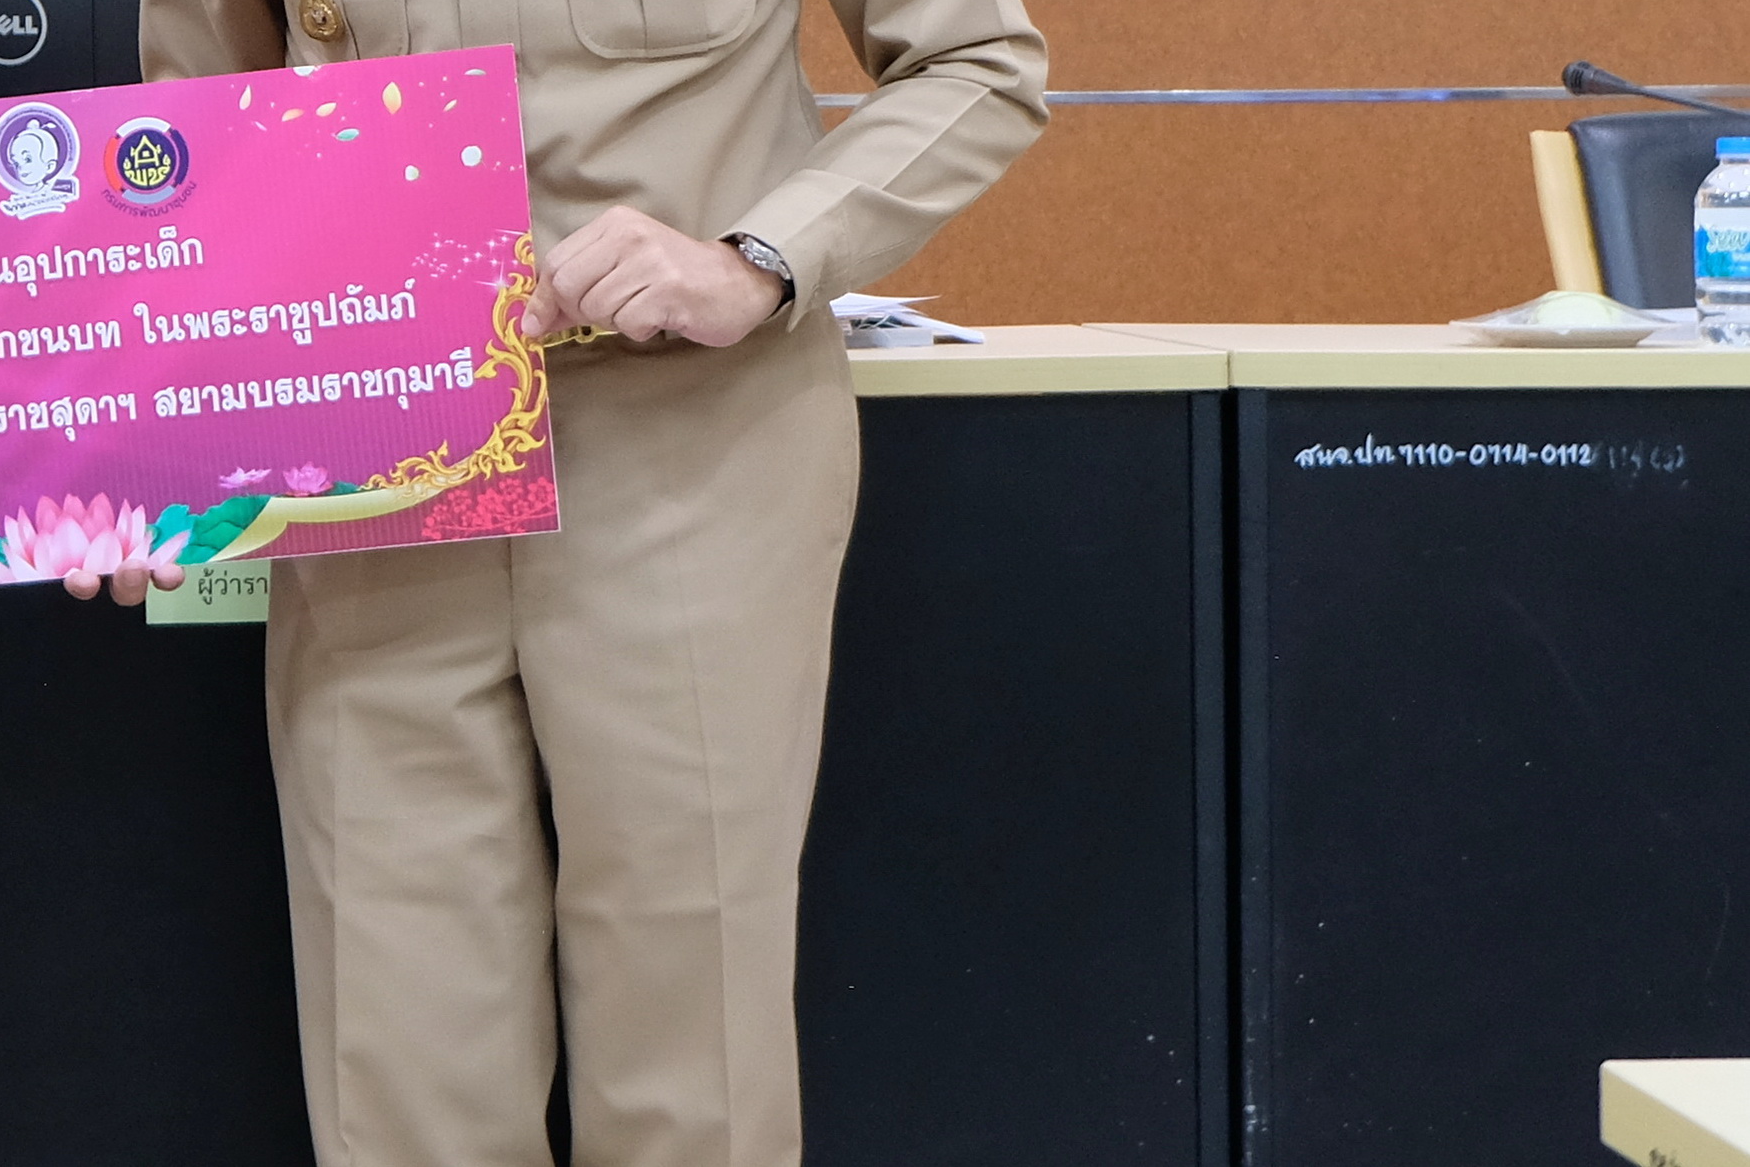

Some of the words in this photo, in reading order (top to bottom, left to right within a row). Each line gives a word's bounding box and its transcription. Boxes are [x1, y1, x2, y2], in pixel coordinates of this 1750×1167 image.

[133, 277, 417, 345] ในพระราชูปถัมภ์
[153, 346, 475, 419] สยามบรมราชกุมารี
